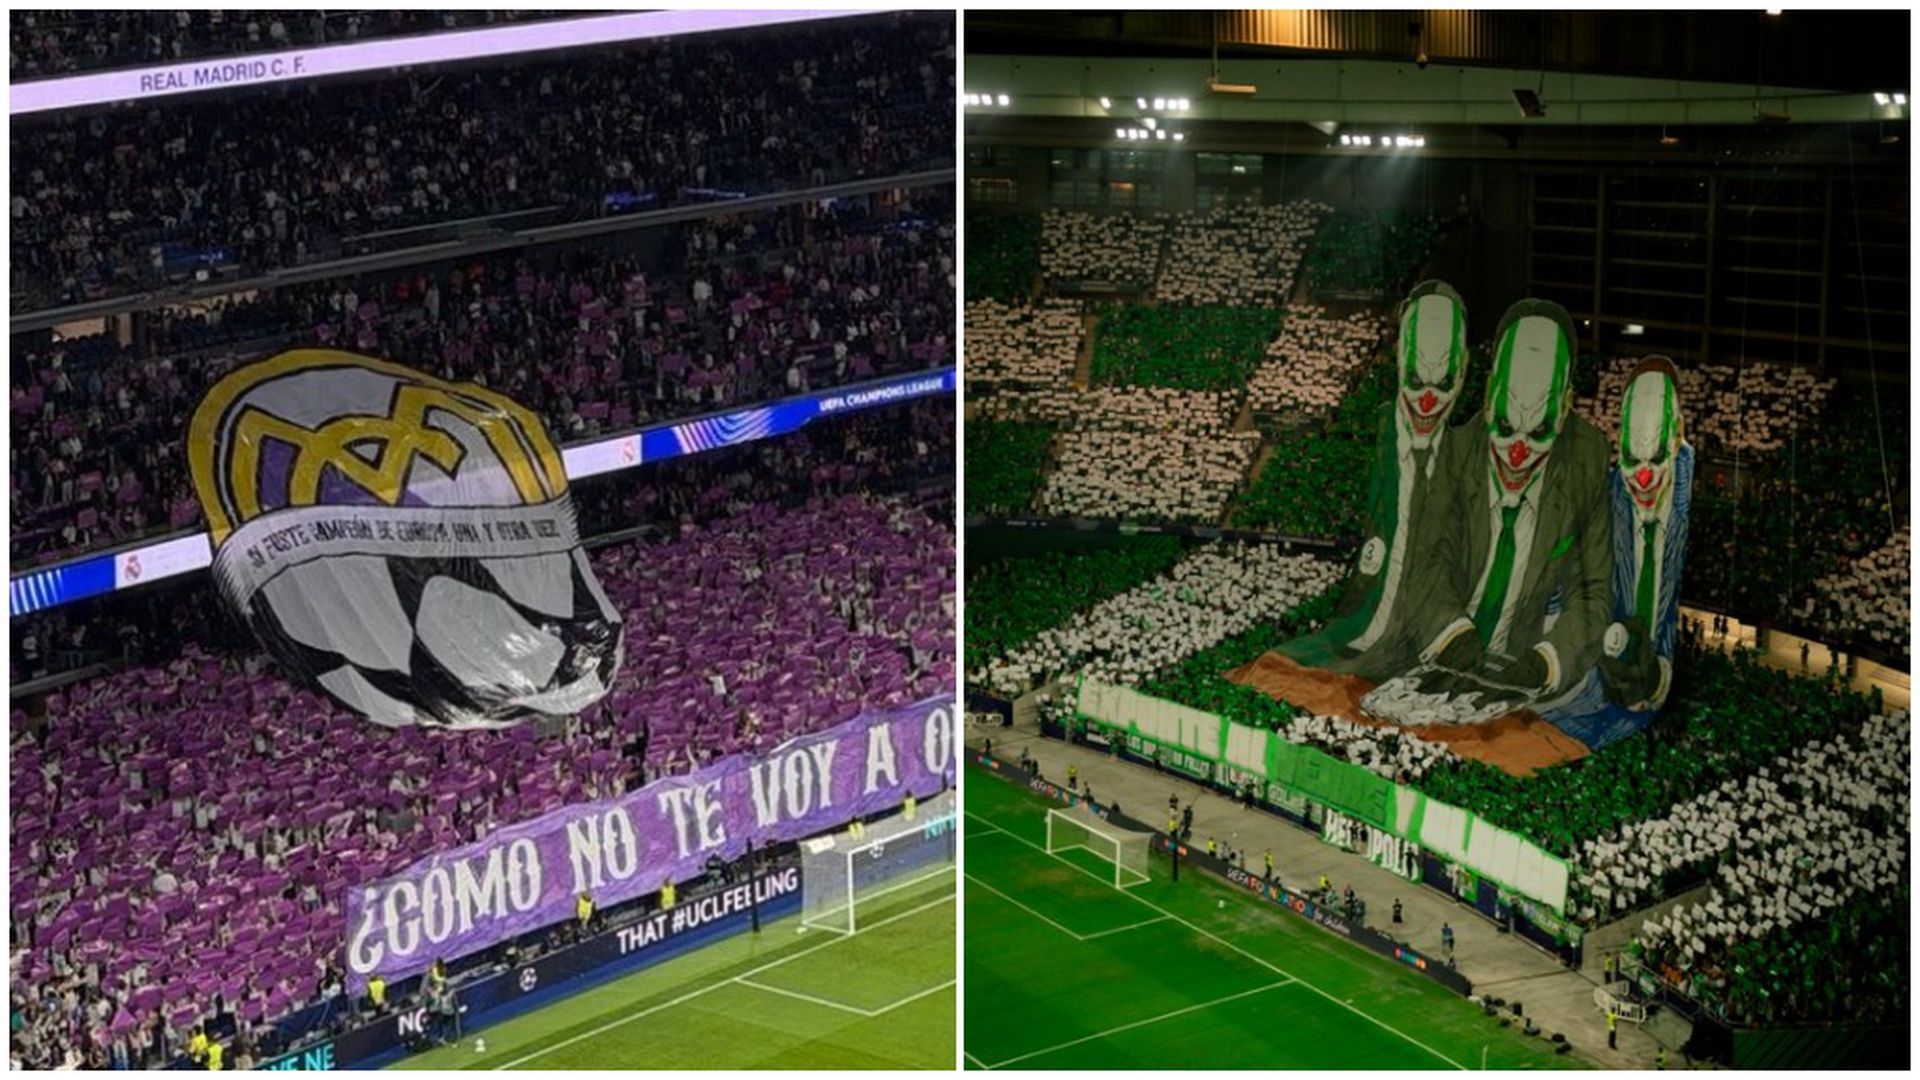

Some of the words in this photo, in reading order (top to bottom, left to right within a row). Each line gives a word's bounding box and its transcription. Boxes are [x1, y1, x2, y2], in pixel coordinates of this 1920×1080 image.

[141, 72, 188, 92] REAL
[194, 61, 266, 86] MADRID
[294, 56, 306, 73] F.
[820, 397, 846, 412] UEFA
[847, 385, 904, 406] CHAMPIONS
[906, 378, 943, 395] LEAGUE
[482, 522, 494, 542] Y
[350, 838, 541, 974] ¿CÓMO
[566, 806, 637, 894] NO
[658, 778, 726, 859] TE
[750, 739, 839, 828] VOY
[863, 721, 899, 795] A
[1227, 867, 1249, 884] UEFA
[617, 914, 667, 955] THAT
[672, 868, 797, 933] #UCLFEELING
